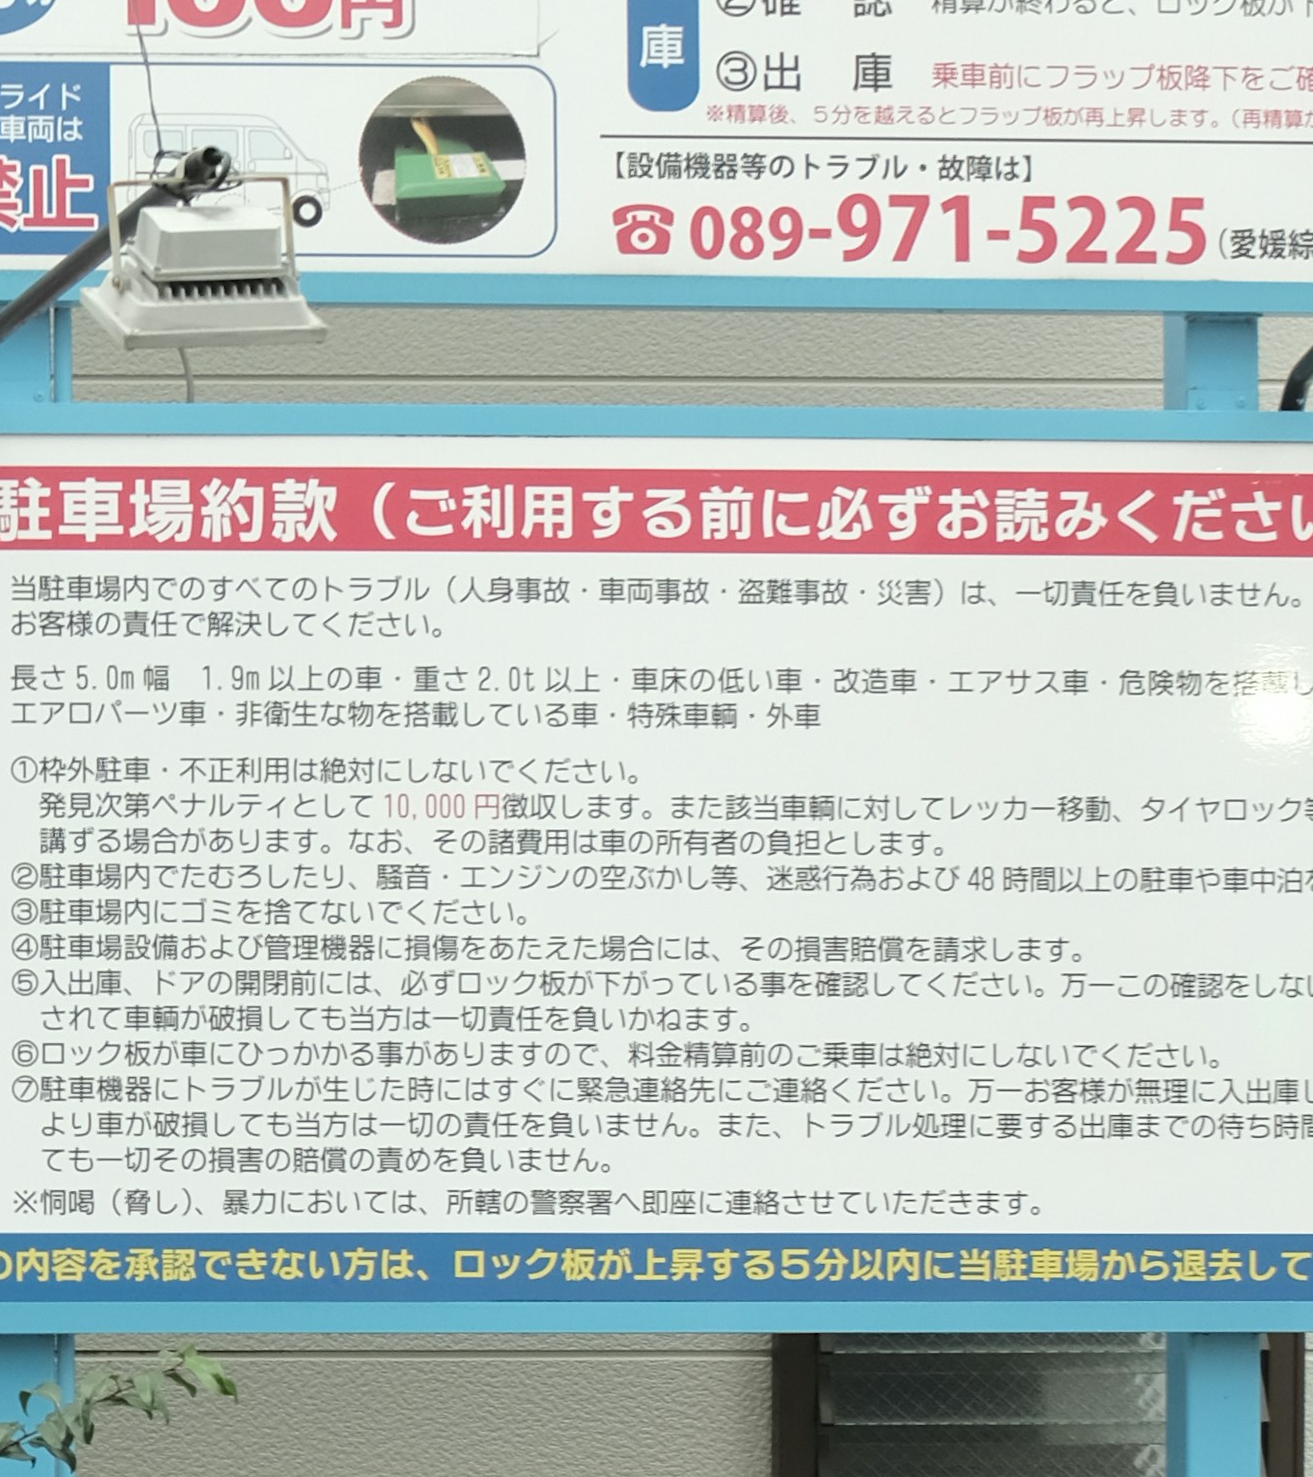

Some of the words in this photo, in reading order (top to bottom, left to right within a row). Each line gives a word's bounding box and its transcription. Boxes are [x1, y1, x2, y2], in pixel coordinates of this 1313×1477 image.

[690, 193, 1206, 265] 089-971-5225
[12, 611, 441, 637] お客様の責任で解決してください。
[12, 969, 1313, 998] ⑤入出庫、ドアの開閉前には、必ずロック板が下がっている事を確認してください。万一この確認をしな
[43, 1147, 610, 1173] ても一切その損害の賠償の責めを負いません。
